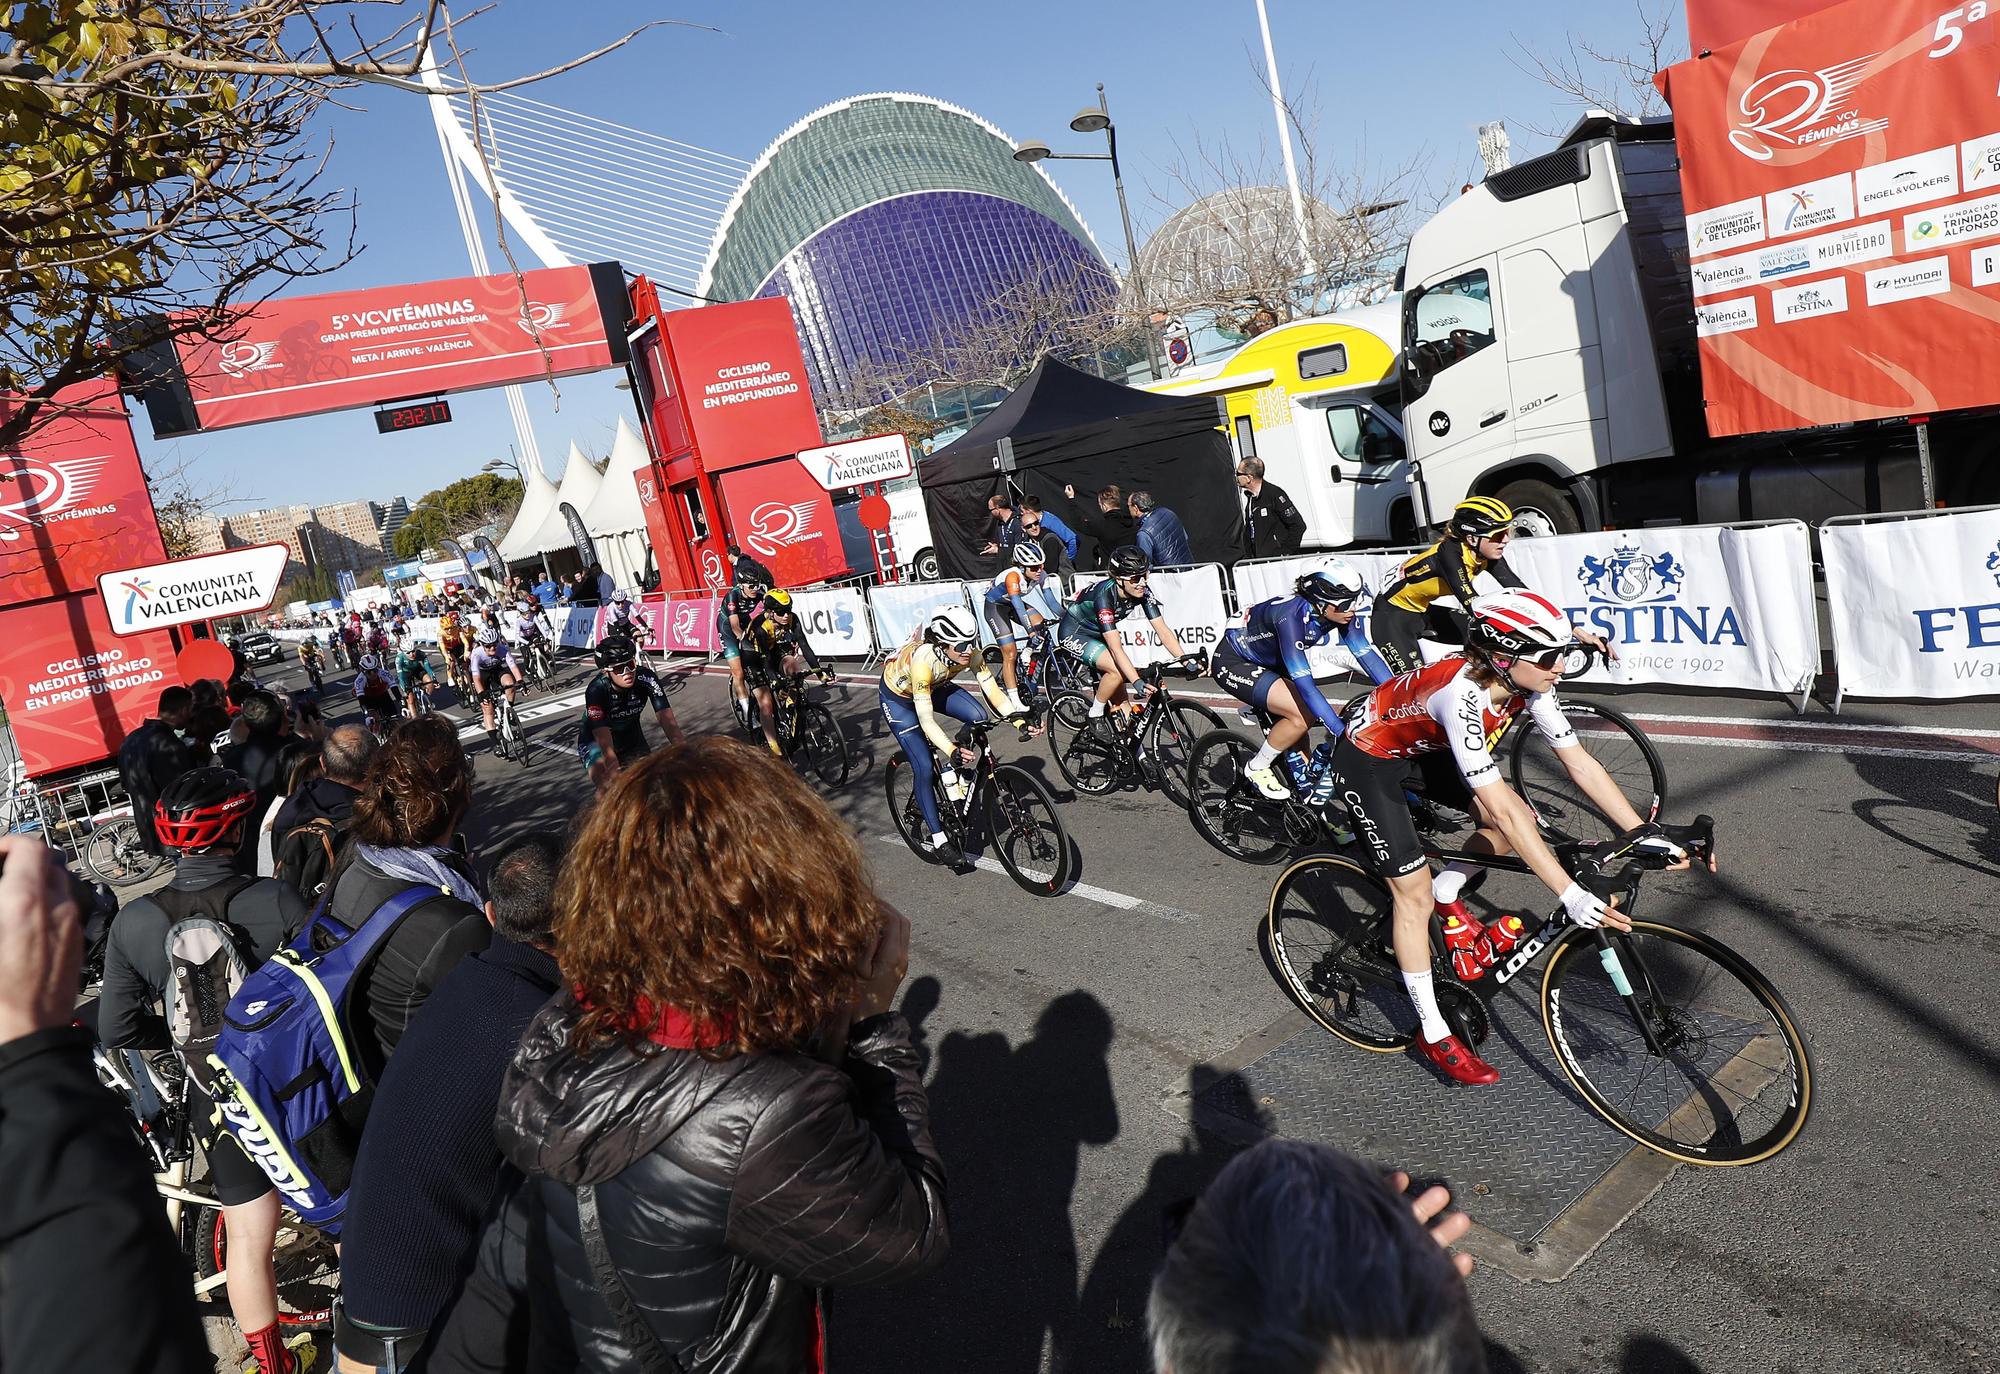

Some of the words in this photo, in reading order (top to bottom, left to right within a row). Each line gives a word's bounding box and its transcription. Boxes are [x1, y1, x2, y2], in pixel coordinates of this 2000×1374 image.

[1836, 109, 1859, 122] VCV
[1798, 119, 1860, 145] FÉMINAS
[1793, 214, 1836, 229] VALENCIANA
[1794, 207, 1836, 223] COMUNITAT
[1943, 203, 1998, 220] FUNDACIÓN
[1944, 210, 1998, 229] TRINIDAD
[1704, 215, 1754, 235] COMUNITAT
[1709, 231, 1720, 242] DE
[1721, 222, 1762, 239] L'ESPORT
[1944, 219, 1999, 238] ALFONSO
[1818, 233, 1885, 259] MURVIEDRO
[1761, 252, 1808, 268] VALÈNCIA
[1701, 266, 1744, 283] València
[1730, 274, 1752, 285] esports
[1894, 269, 1942, 286] HYUNDAI
[352, 298, 474, 328] VCVFÉMINAS
[1705, 309, 1747, 325] València
[1787, 299, 1833, 315] FESTINA
[320, 332, 349, 343] GRAN
[350, 328, 379, 340] PREMI
[380, 320, 430, 336] DIPUTACIÓ
[431, 318, 445, 329] DE
[444, 313, 488, 327] VALÈNCIA
[1732, 316, 1755, 327] esports
[352, 352, 379, 364] META
[386, 346, 424, 359] ARRIVE:
[426, 339, 473, 353] VALÈNCIA
[718, 361, 770, 379] CICLISMO
[705, 371, 790, 395] MEDITERRÁNEO
[703, 399, 720, 409] EN
[721, 383, 799, 407] PROFUNDIDAD
[1519, 398, 1542, 415] 500
[392, 404, 448, 428] 2:32:17
[845, 449, 900, 467] COMUNITAT
[835, 460, 904, 481] VALENCIANA
[159, 571, 254, 599] COMUNITAT
[140, 585, 261, 618] VALENCIANA
[800, 609, 834, 635] UCI
[1563, 605, 1747, 647] ESTINA
[46, 649, 123, 675] CICLISMO
[1386, 642, 1407, 674] MEUBL
[1628, 652, 1674, 670] since
[1678, 658, 1723, 674] 1902
[28, 655, 152, 695] MEDITERRÁNEO
[1225, 678, 1239, 690] Tech
[1228, 671, 1255, 687] Telefónica
[25, 696, 49, 711] EN
[50, 669, 163, 704] PROFUNDIDAD
[1388, 701, 1426, 721] Cofidis
[1459, 690, 1484, 751] Cofidis
[1344, 791, 1390, 861] Cofidis
[1495, 923, 1561, 984] LOOK
[1548, 987, 1585, 1078] CORIMA
